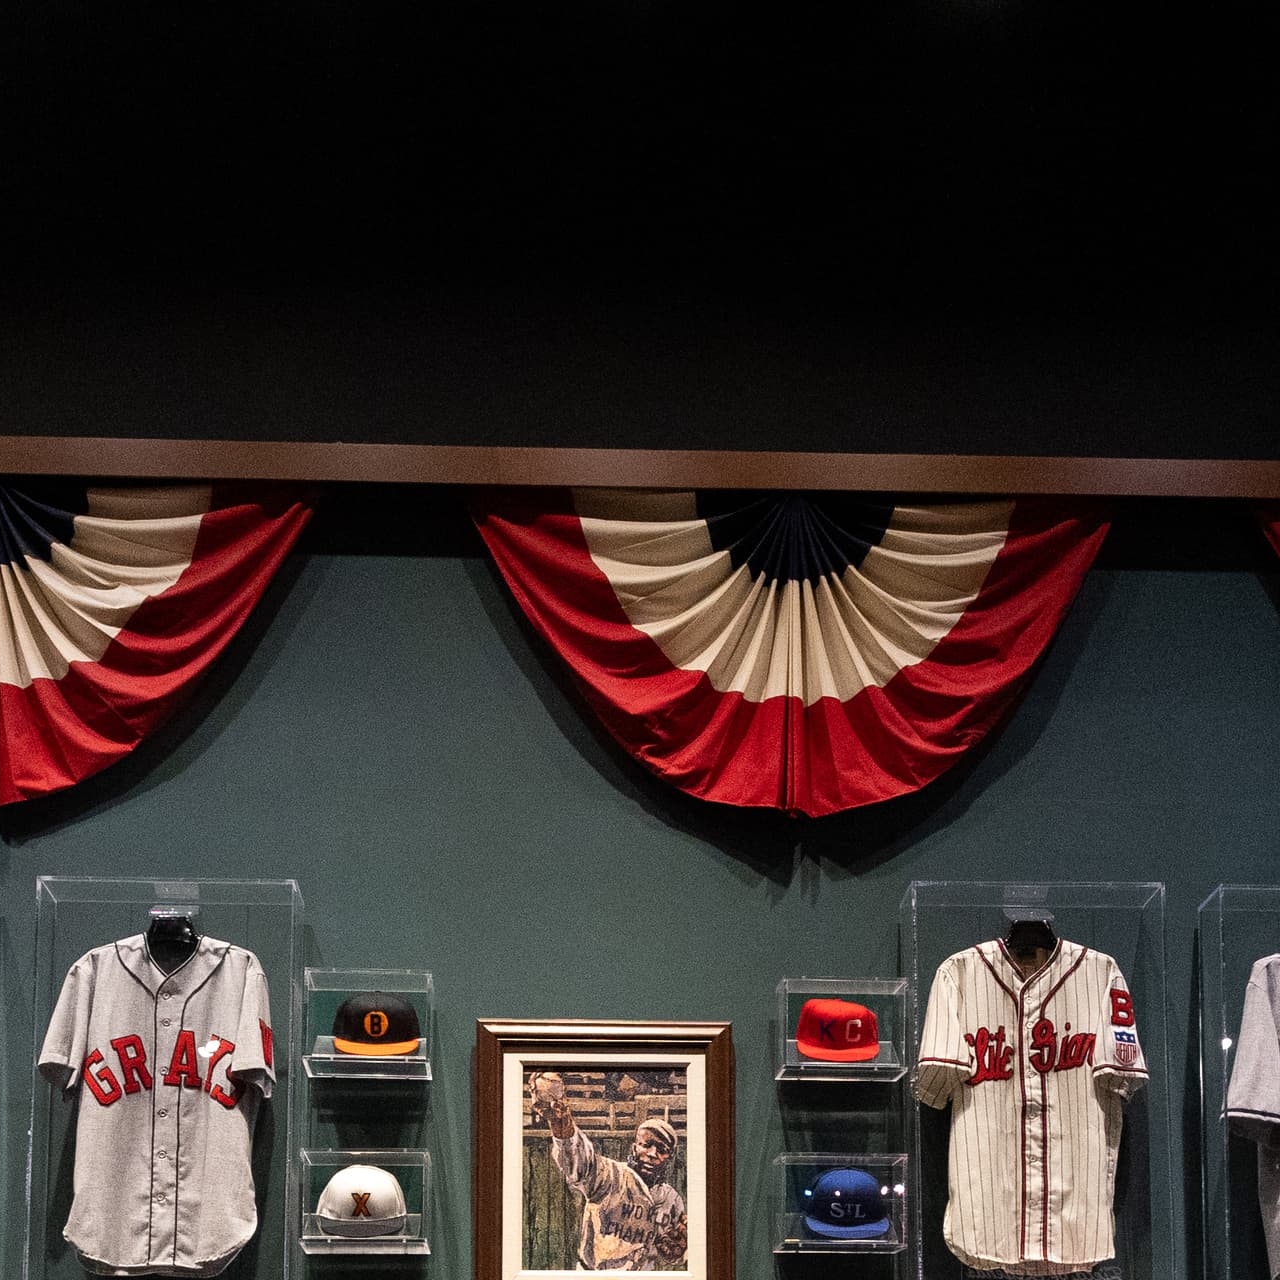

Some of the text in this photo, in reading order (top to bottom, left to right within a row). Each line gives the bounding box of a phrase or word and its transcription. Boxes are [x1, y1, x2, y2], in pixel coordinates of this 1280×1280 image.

[1110, 988, 1135, 1027] B
[370, 1014, 381, 1034] B
[351, 1193, 371, 1216] X
